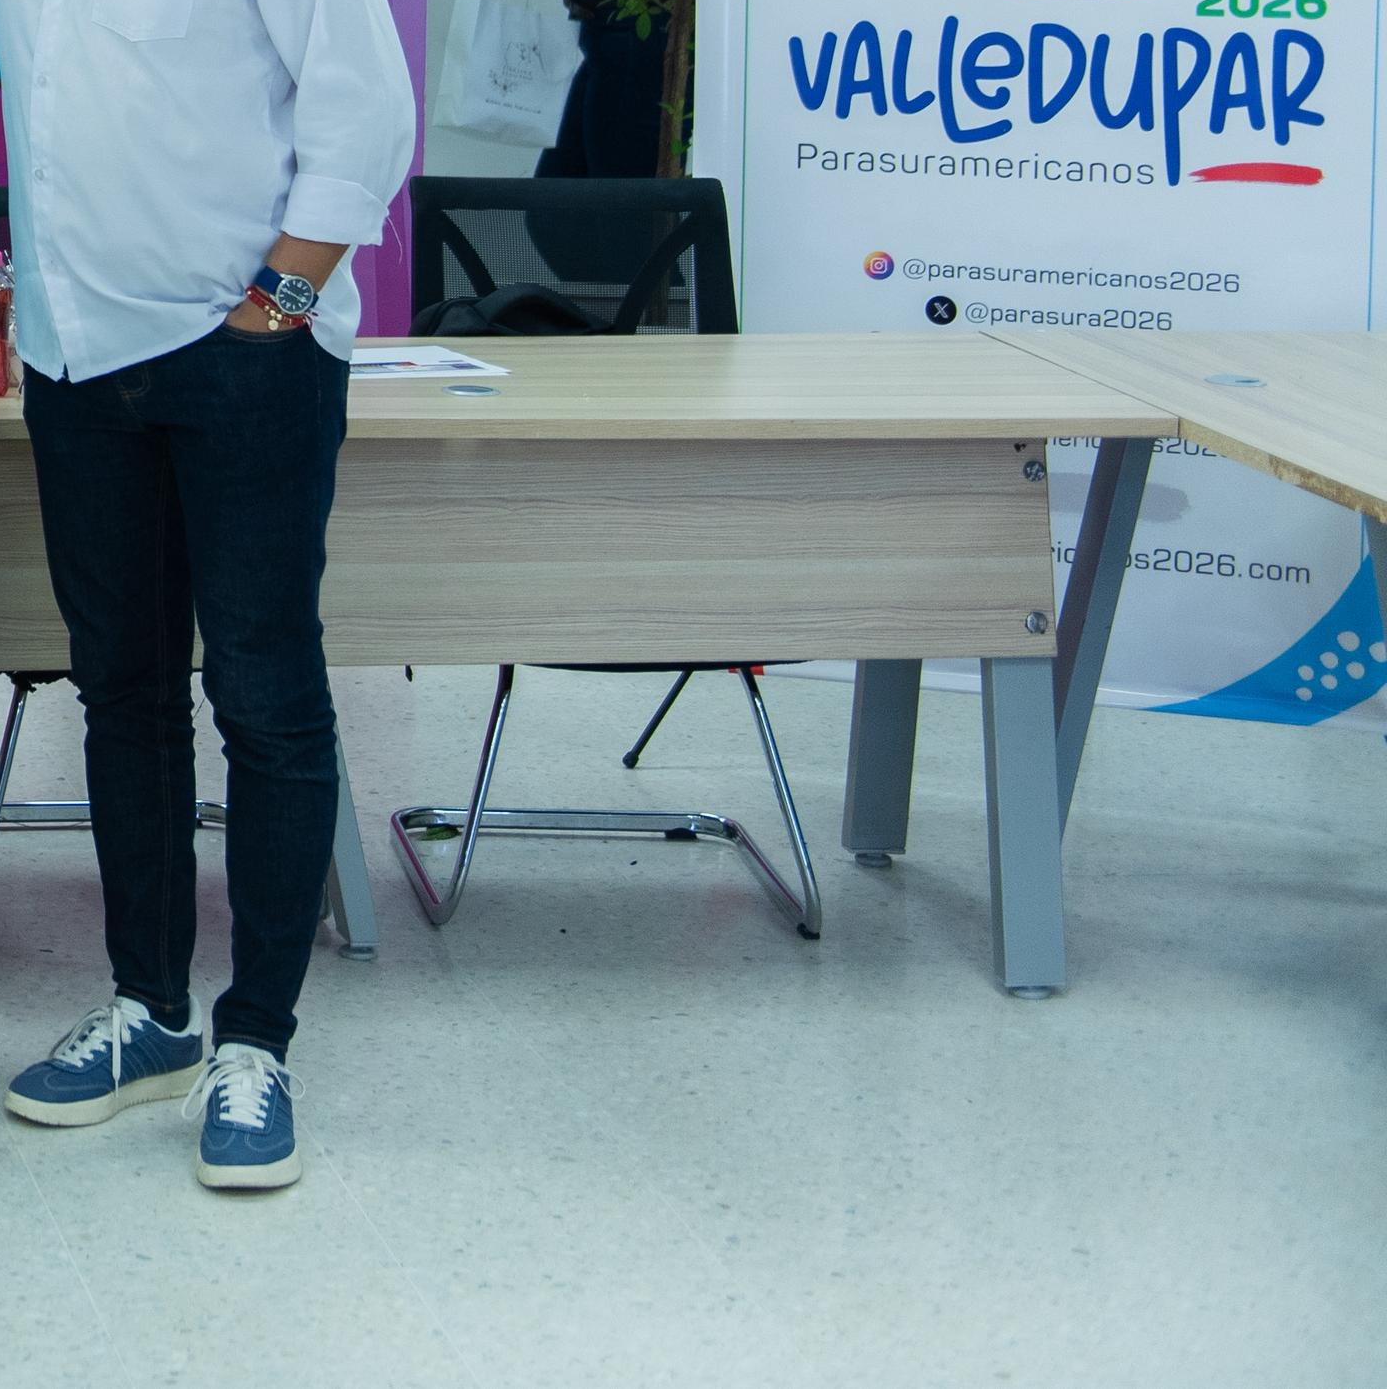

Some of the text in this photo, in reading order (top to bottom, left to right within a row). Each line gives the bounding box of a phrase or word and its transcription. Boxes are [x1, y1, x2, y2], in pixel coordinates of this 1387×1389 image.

[796, 142, 1155, 186] Parasuramericanos
[901, 257, 1241, 294] @parasuramericanos2026
[964, 301, 1173, 332] @parasura2026
